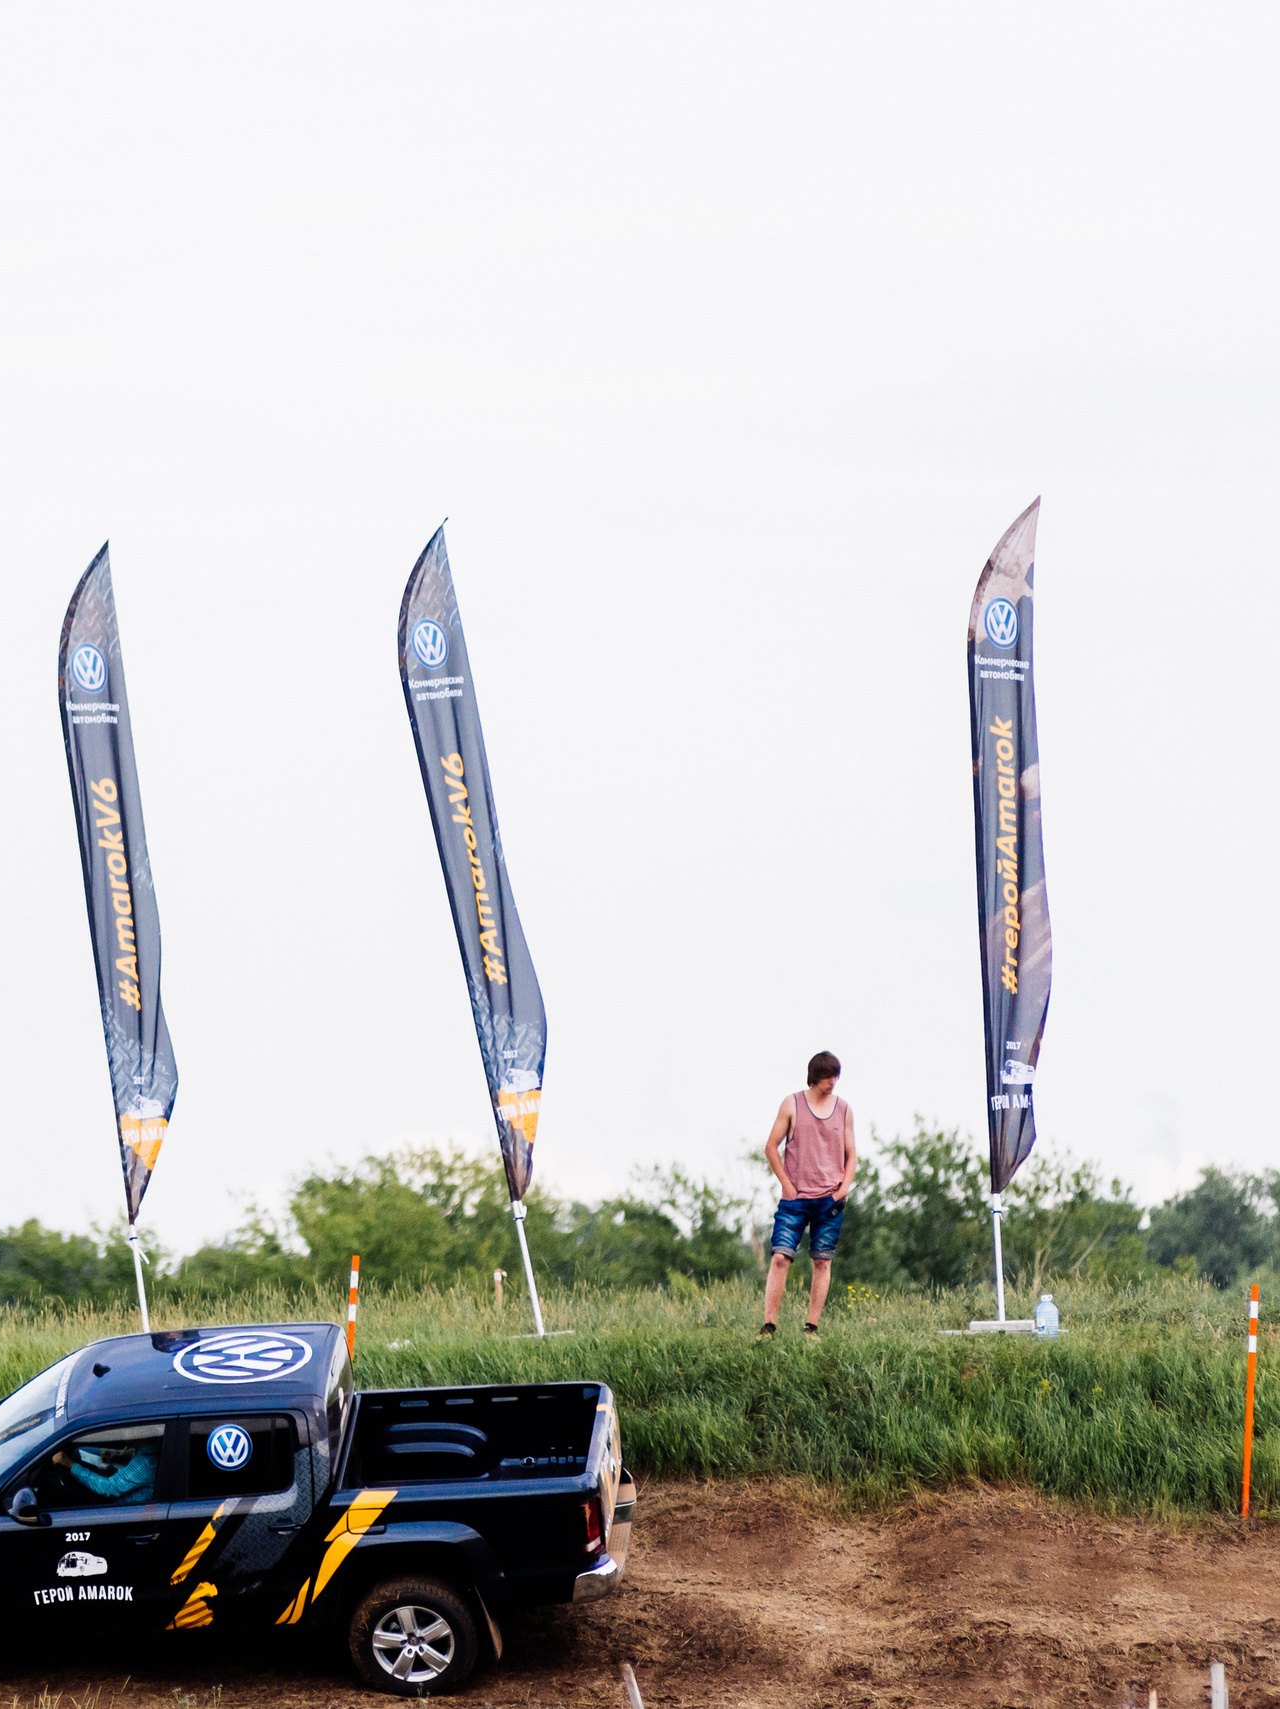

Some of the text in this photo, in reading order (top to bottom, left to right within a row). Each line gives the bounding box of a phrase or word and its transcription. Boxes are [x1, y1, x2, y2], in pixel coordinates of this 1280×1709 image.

[408, 675, 464, 689] Коммерческие
[990, 716, 1020, 995] #геройAmarok
[440, 752, 508, 985] #AmarokV6
[91, 777, 142, 1011] #AmarokV6
[1006, 1041, 1021, 1050] 2017
[65, 1532, 91, 1542] 2017
[34, 1585, 134, 1606] ГЕРОЙ AMAROK
